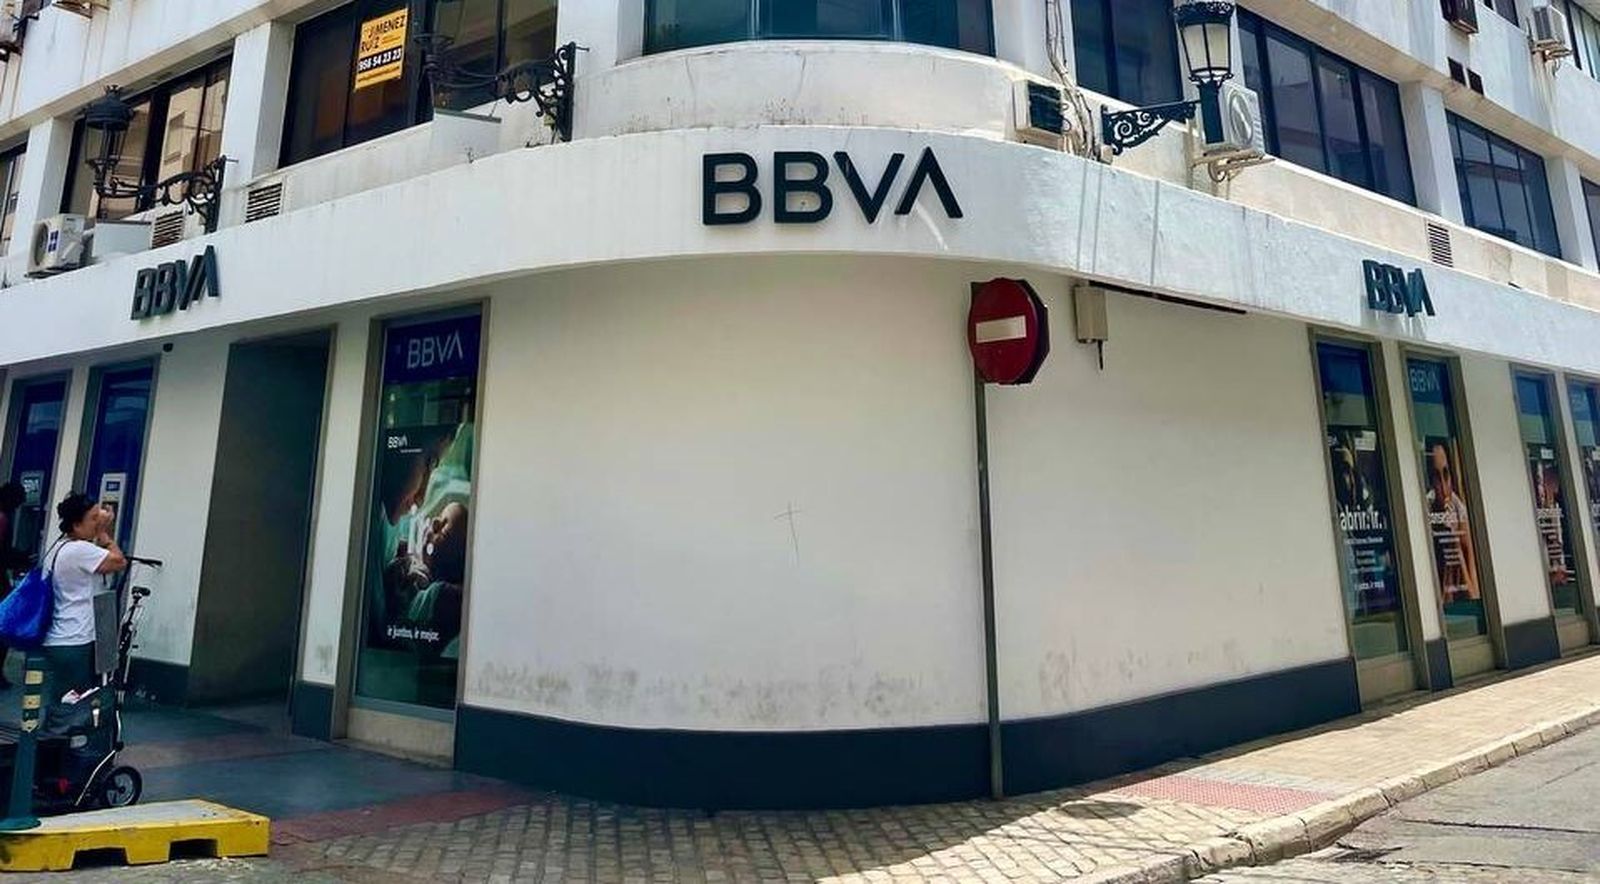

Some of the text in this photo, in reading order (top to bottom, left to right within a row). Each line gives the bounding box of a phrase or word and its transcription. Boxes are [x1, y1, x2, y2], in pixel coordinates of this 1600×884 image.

[702, 147, 963, 225] BBVA
[131, 245, 219, 320] BBVA
[1362, 259, 1435, 317] BBVA
[407, 330, 463, 369] BBVA
[388, 435, 408, 449] BBVA
